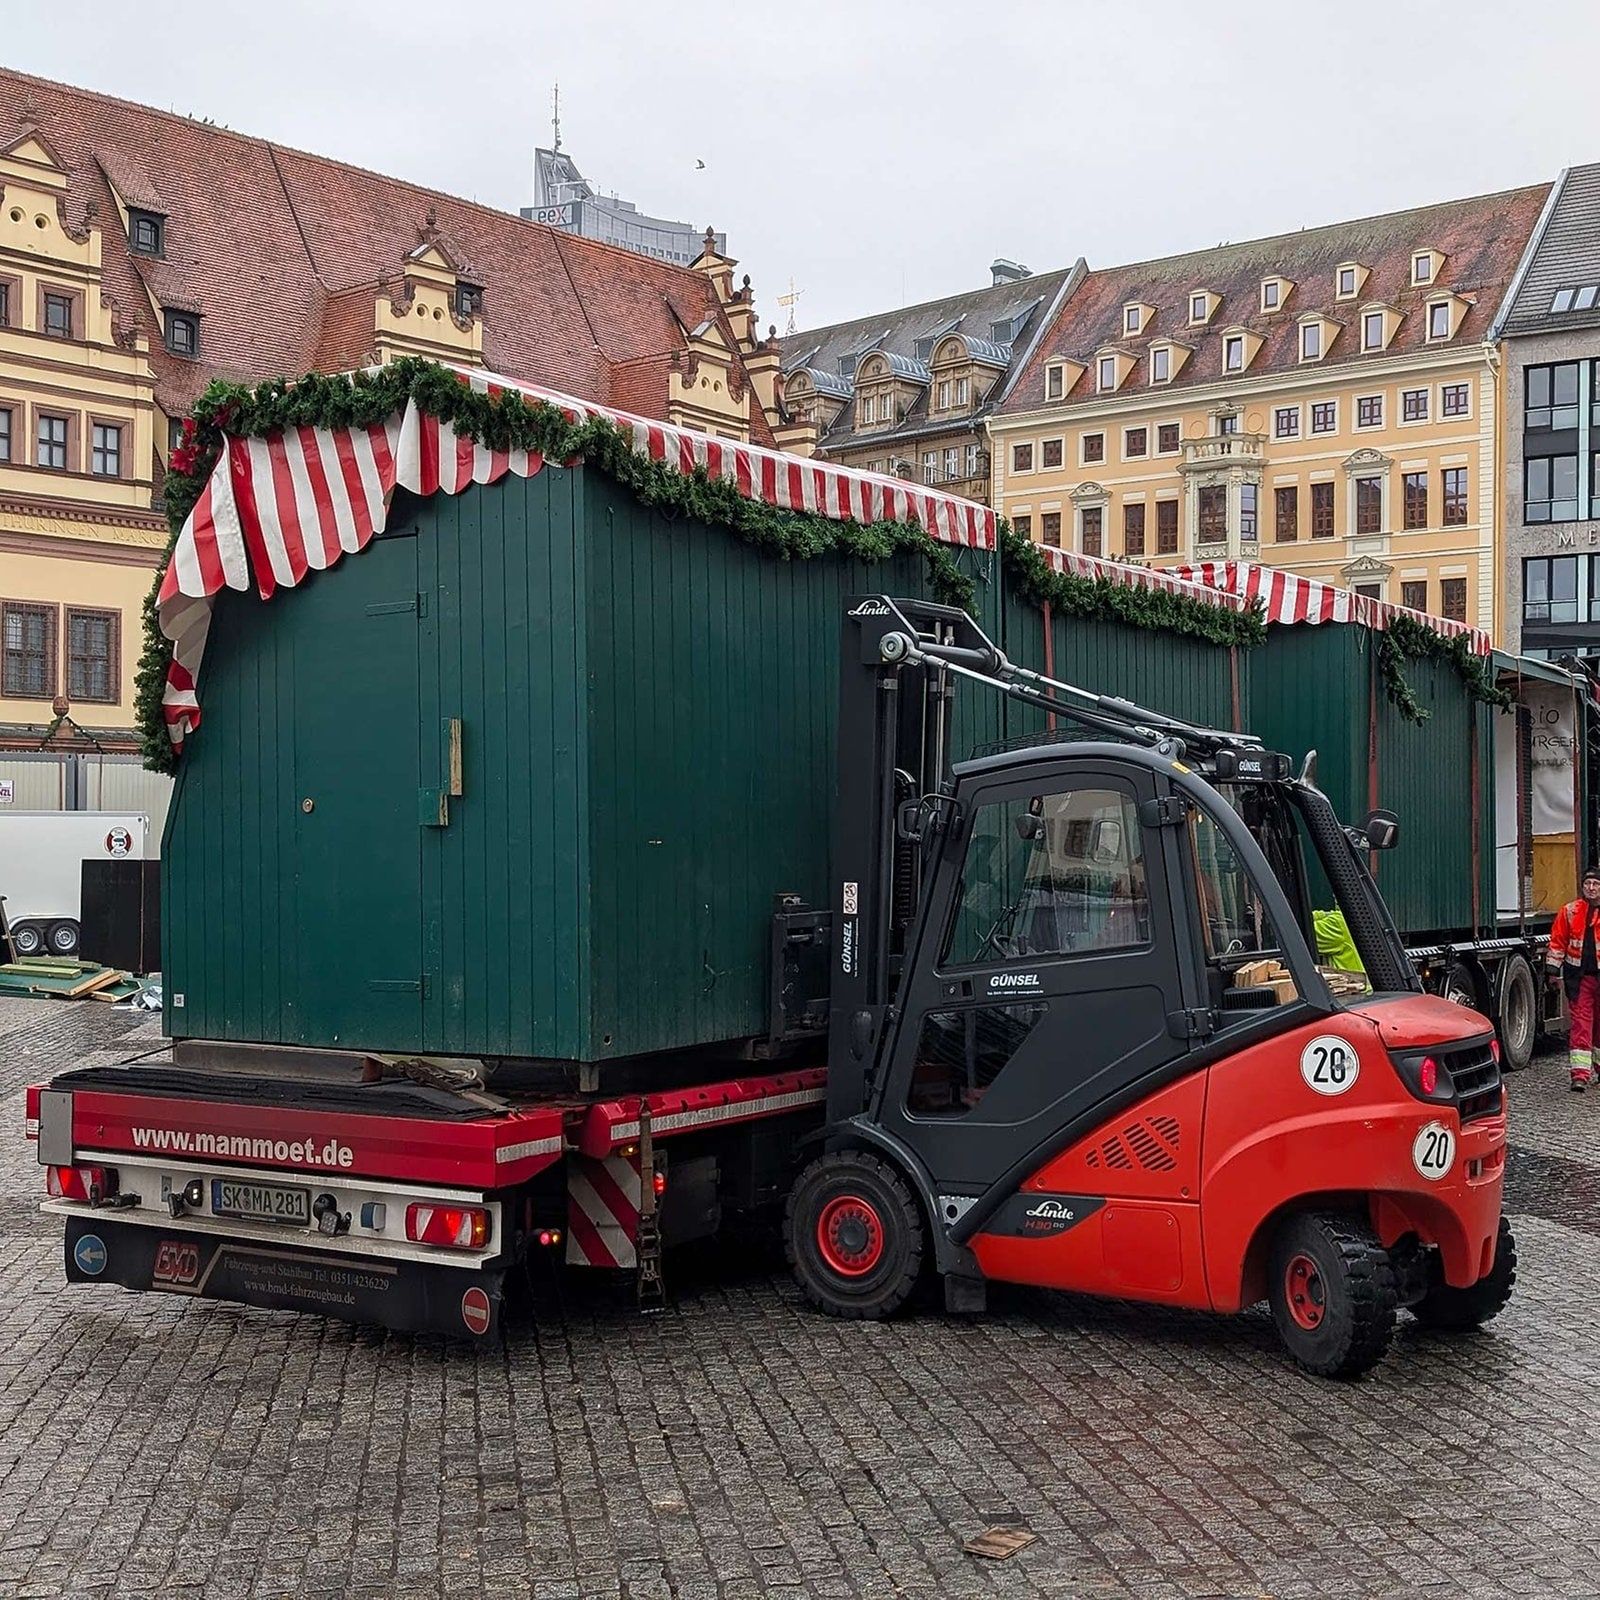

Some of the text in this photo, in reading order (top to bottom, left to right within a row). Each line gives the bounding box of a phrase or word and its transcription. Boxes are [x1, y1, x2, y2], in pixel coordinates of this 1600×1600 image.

[538, 206, 567, 224] eex
[847, 599, 891, 616] Linde
[1239, 759, 1261, 772] GÜNSEL
[841, 921, 852, 974] GÜNSEL
[990, 973, 1040, 987] GÜNSEL
[1313, 1047, 1347, 1084] 20
[132, 1127, 354, 1168] www.mammoet.de
[1421, 1131, 1449, 1169] 20
[223, 1186, 305, 1217] SK MA 281
[1026, 1200, 1074, 1220] Linde
